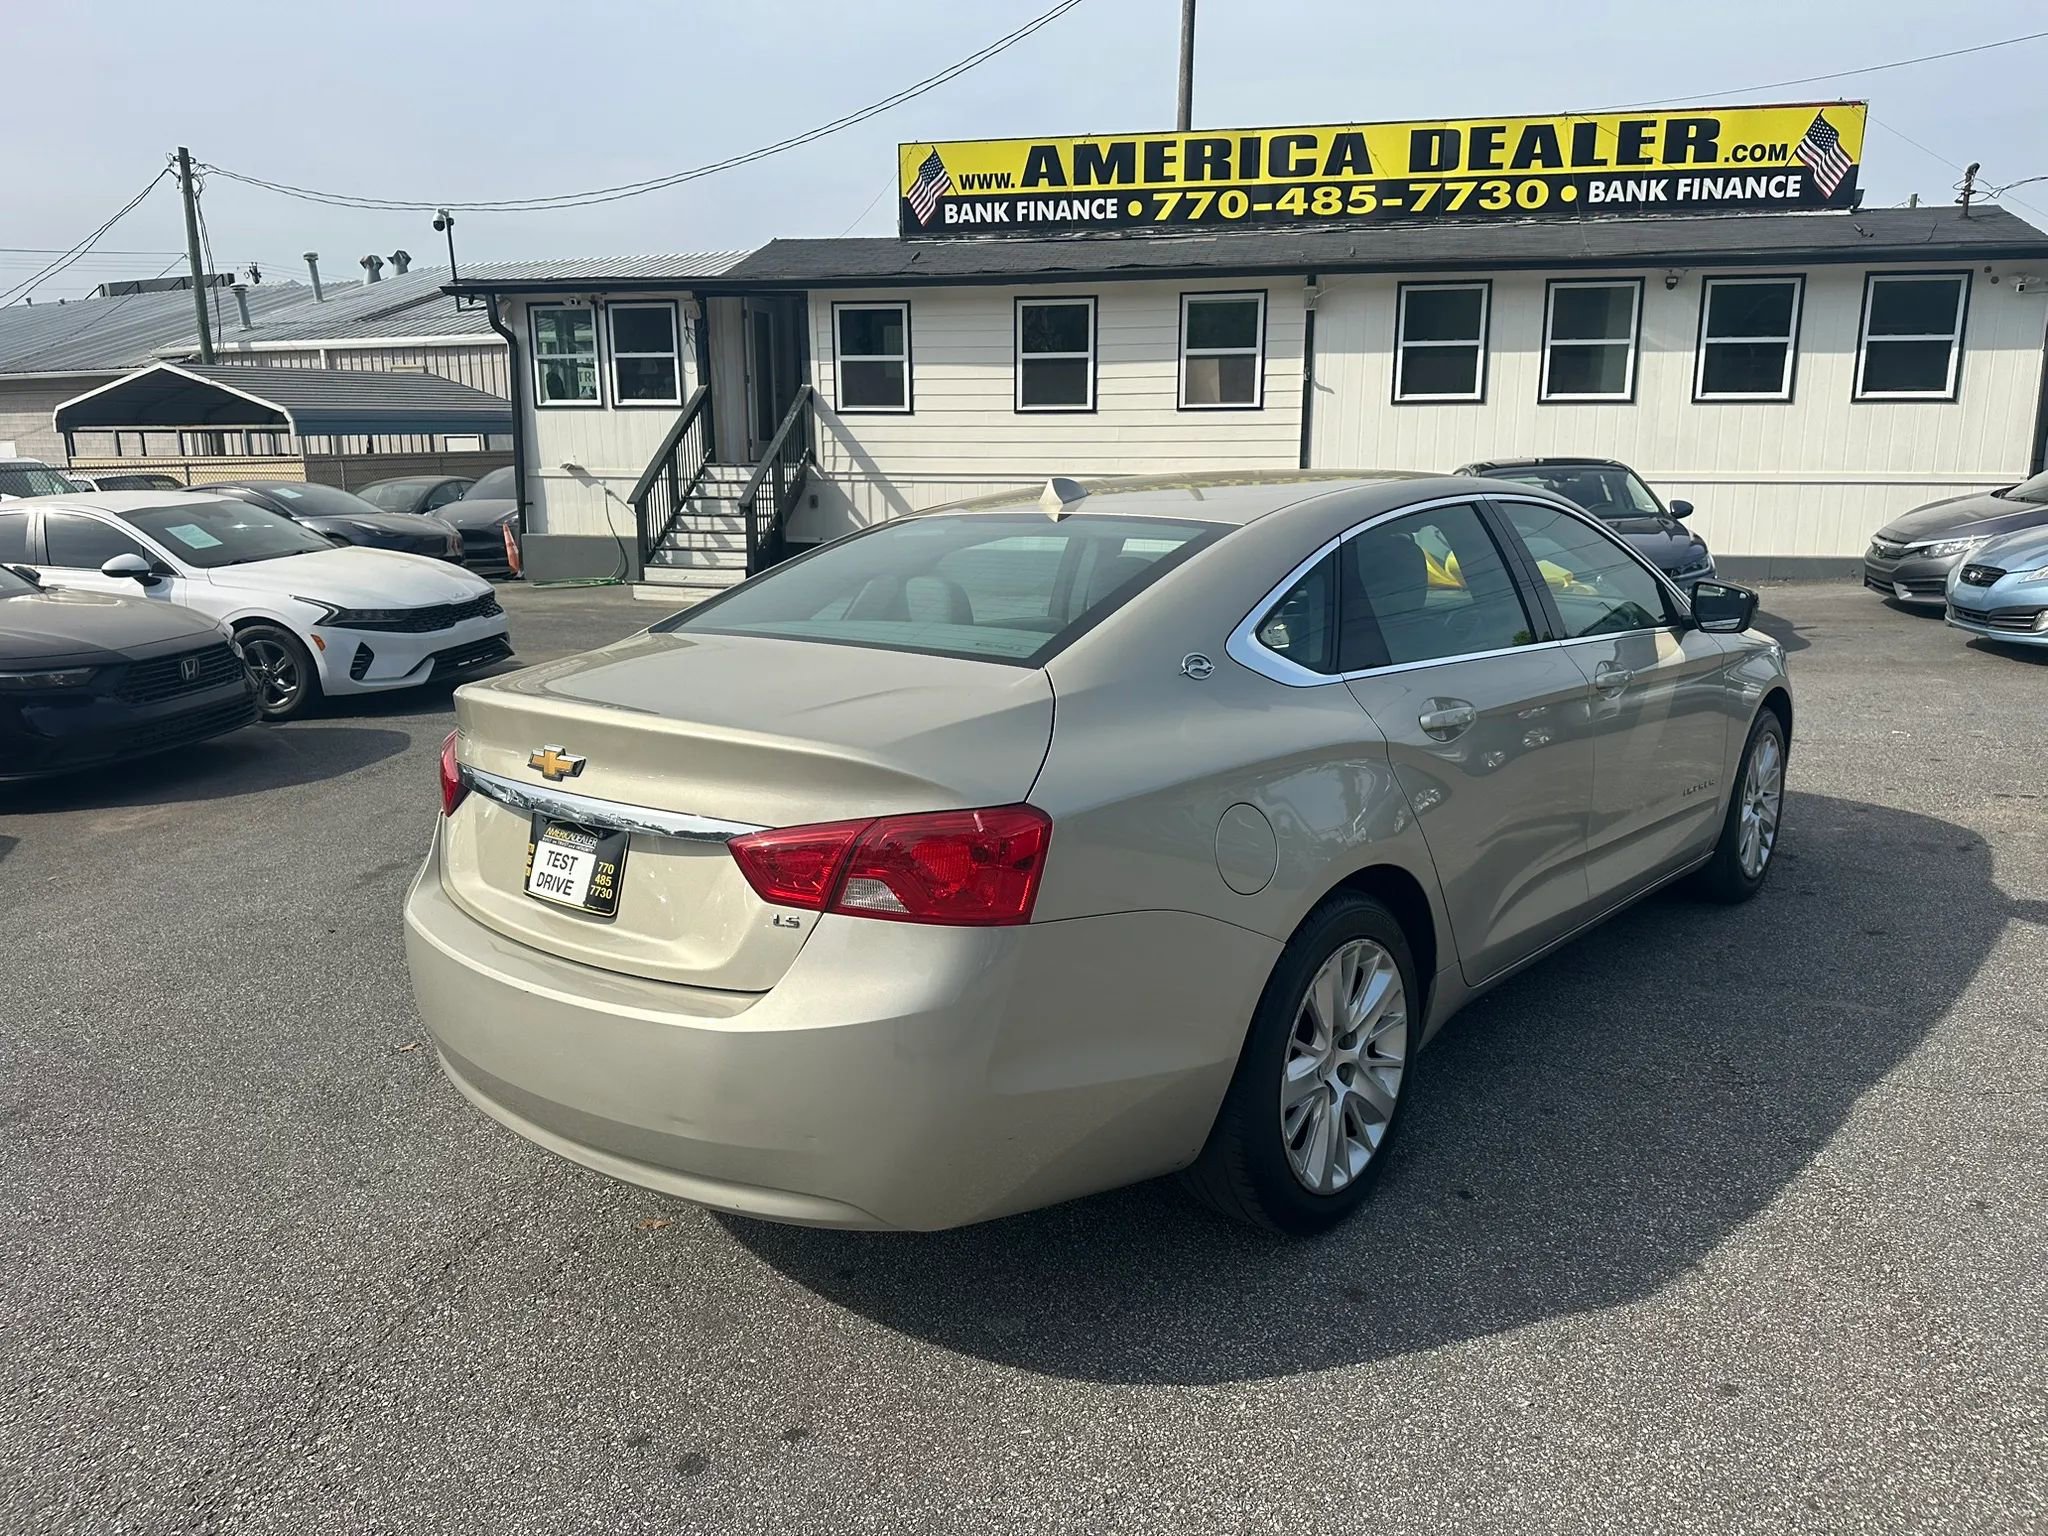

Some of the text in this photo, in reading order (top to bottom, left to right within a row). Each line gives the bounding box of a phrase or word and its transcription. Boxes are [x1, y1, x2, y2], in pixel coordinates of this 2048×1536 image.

[1020, 132, 1373, 188] AMERICA
[1408, 118, 1721, 173] DEALER
[944, 175, 1802, 224] BANK FINANCE 770-485-7730 BANK FINANCE
[546, 850, 579, 873] TEST
[598, 861, 615, 875] 770
[536, 871, 575, 896] DRIVE
[594, 873, 612, 887] 485
[589, 884, 613, 899] 7730
[773, 913, 800, 929] LS
